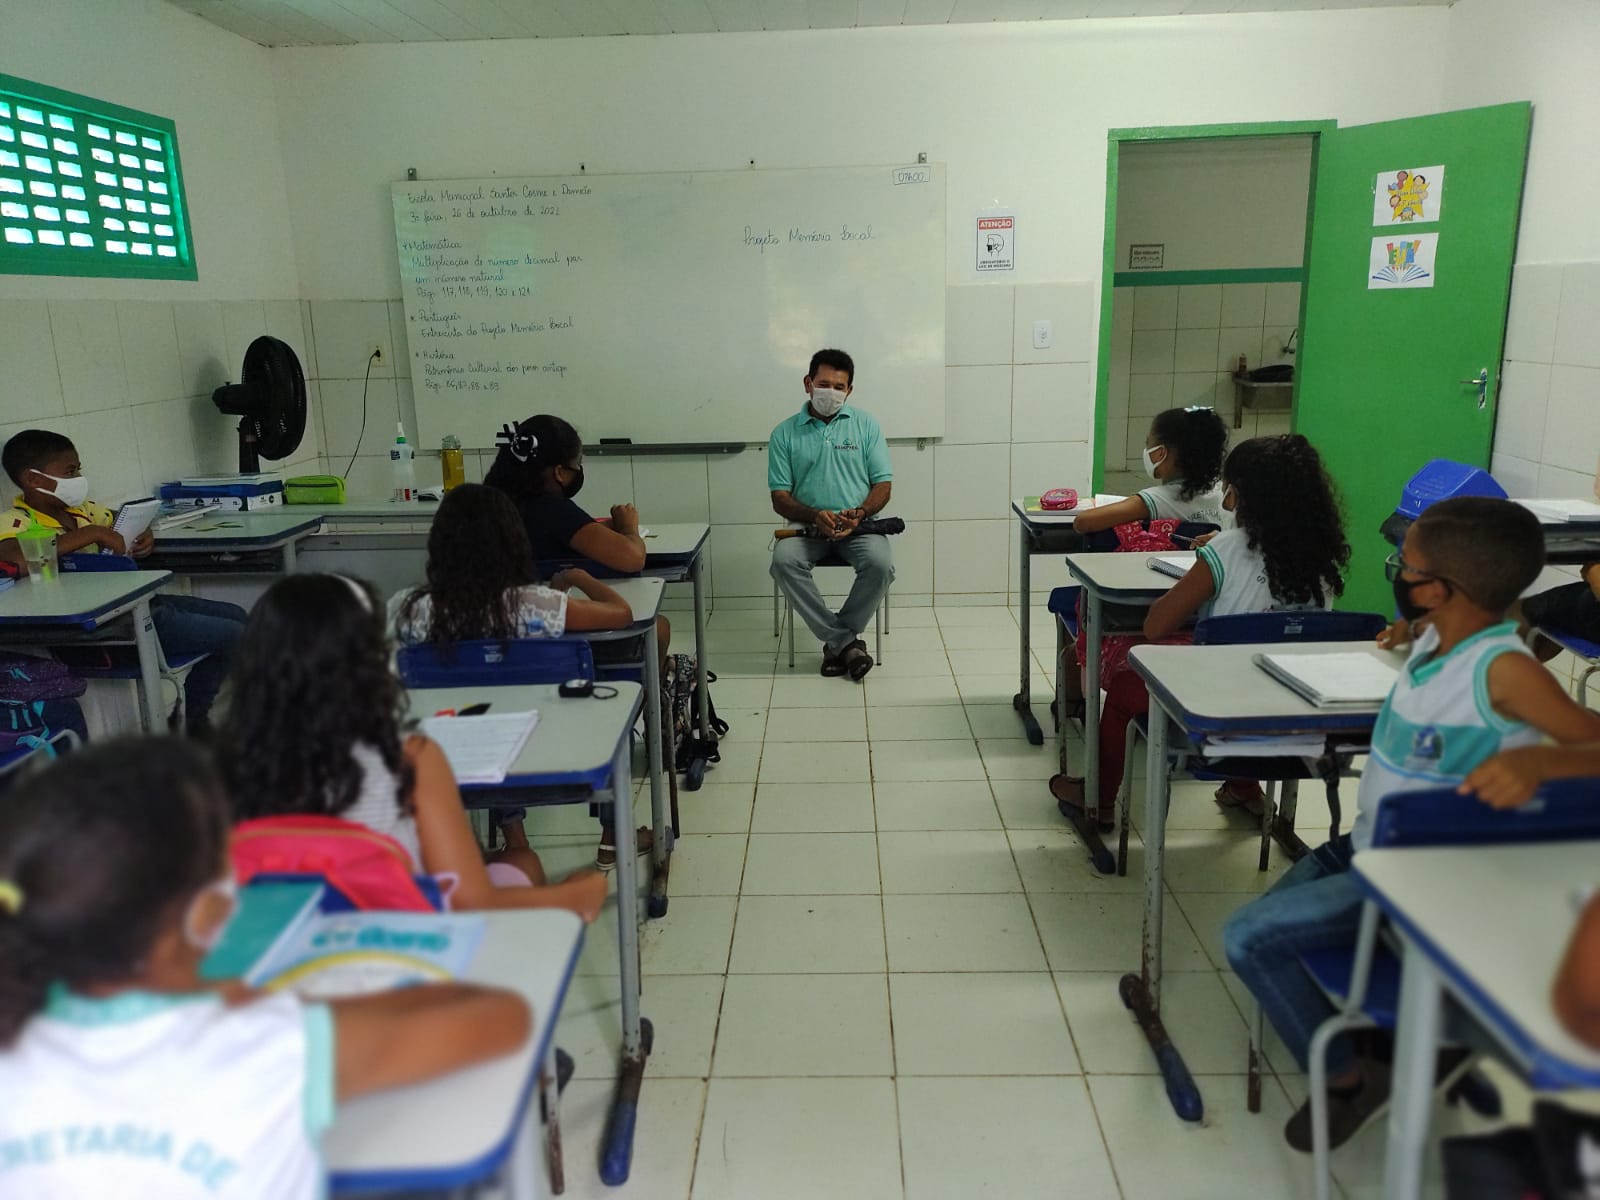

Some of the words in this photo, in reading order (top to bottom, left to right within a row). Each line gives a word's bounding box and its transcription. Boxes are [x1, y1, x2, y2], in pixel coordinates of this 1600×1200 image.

[408, 189, 435, 204] Escola
[440, 186, 484, 205] Municipal
[522, 184, 548, 198] Cosme
[467, 207, 475, 218] de
[480, 204, 518, 218] outubro
[524, 204, 536, 216] de
[979, 219, 1012, 229] ATENÇÃO
[744, 225, 780, 254] Projeto
[789, 226, 832, 243] Memória
[841, 223, 874, 241] Local
[411, 254, 469, 271] Multiplicação
[474, 255, 483, 266] de
[525, 251, 561, 265] decimal
[415, 276, 430, 284] um
[469, 268, 505, 283] natural
[549, 315, 574, 330] Local
[467, 359, 502, 374] Cultural
[1187, 509, 1221, 522] RETARIA
[0, 1121, 173, 1174] RETARIA
